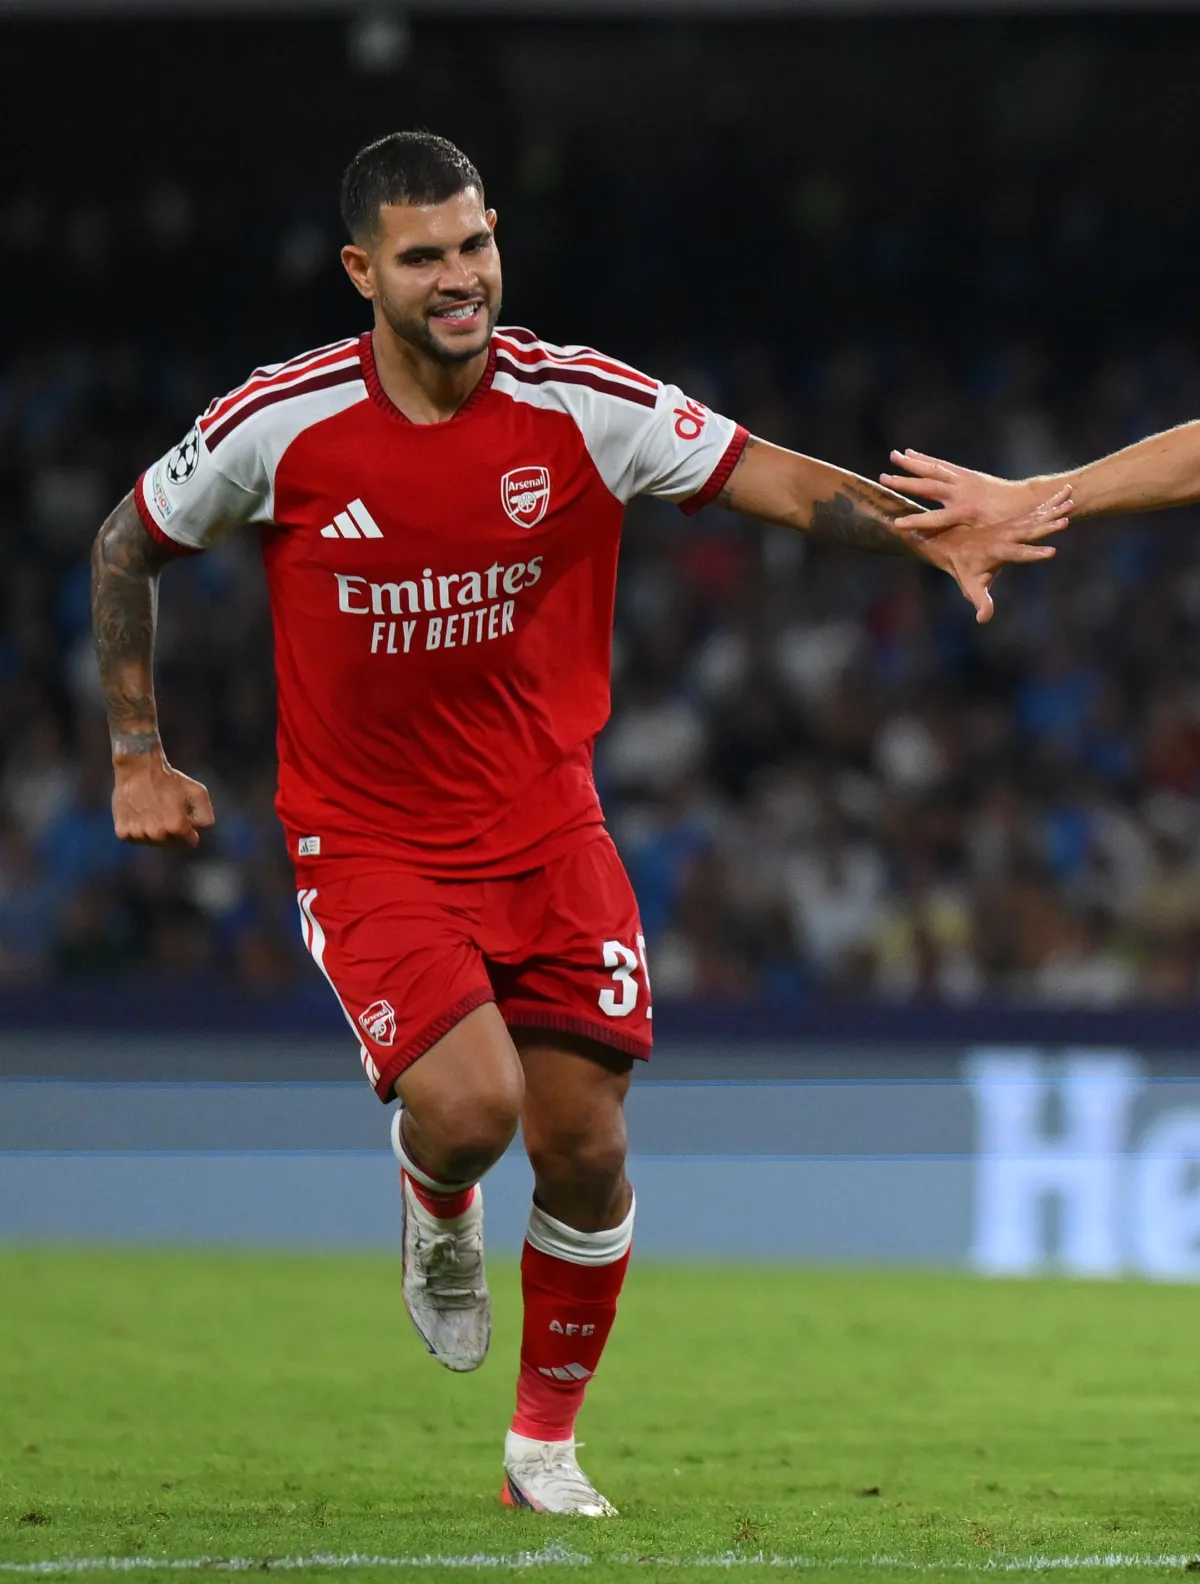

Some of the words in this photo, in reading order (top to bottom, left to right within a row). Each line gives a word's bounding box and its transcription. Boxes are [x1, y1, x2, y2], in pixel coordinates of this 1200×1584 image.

[508, 475, 544, 491] Arsenal
[334, 555, 543, 616] Emirates
[371, 620, 417, 654] FLY
[426, 600, 515, 650] BETTER
